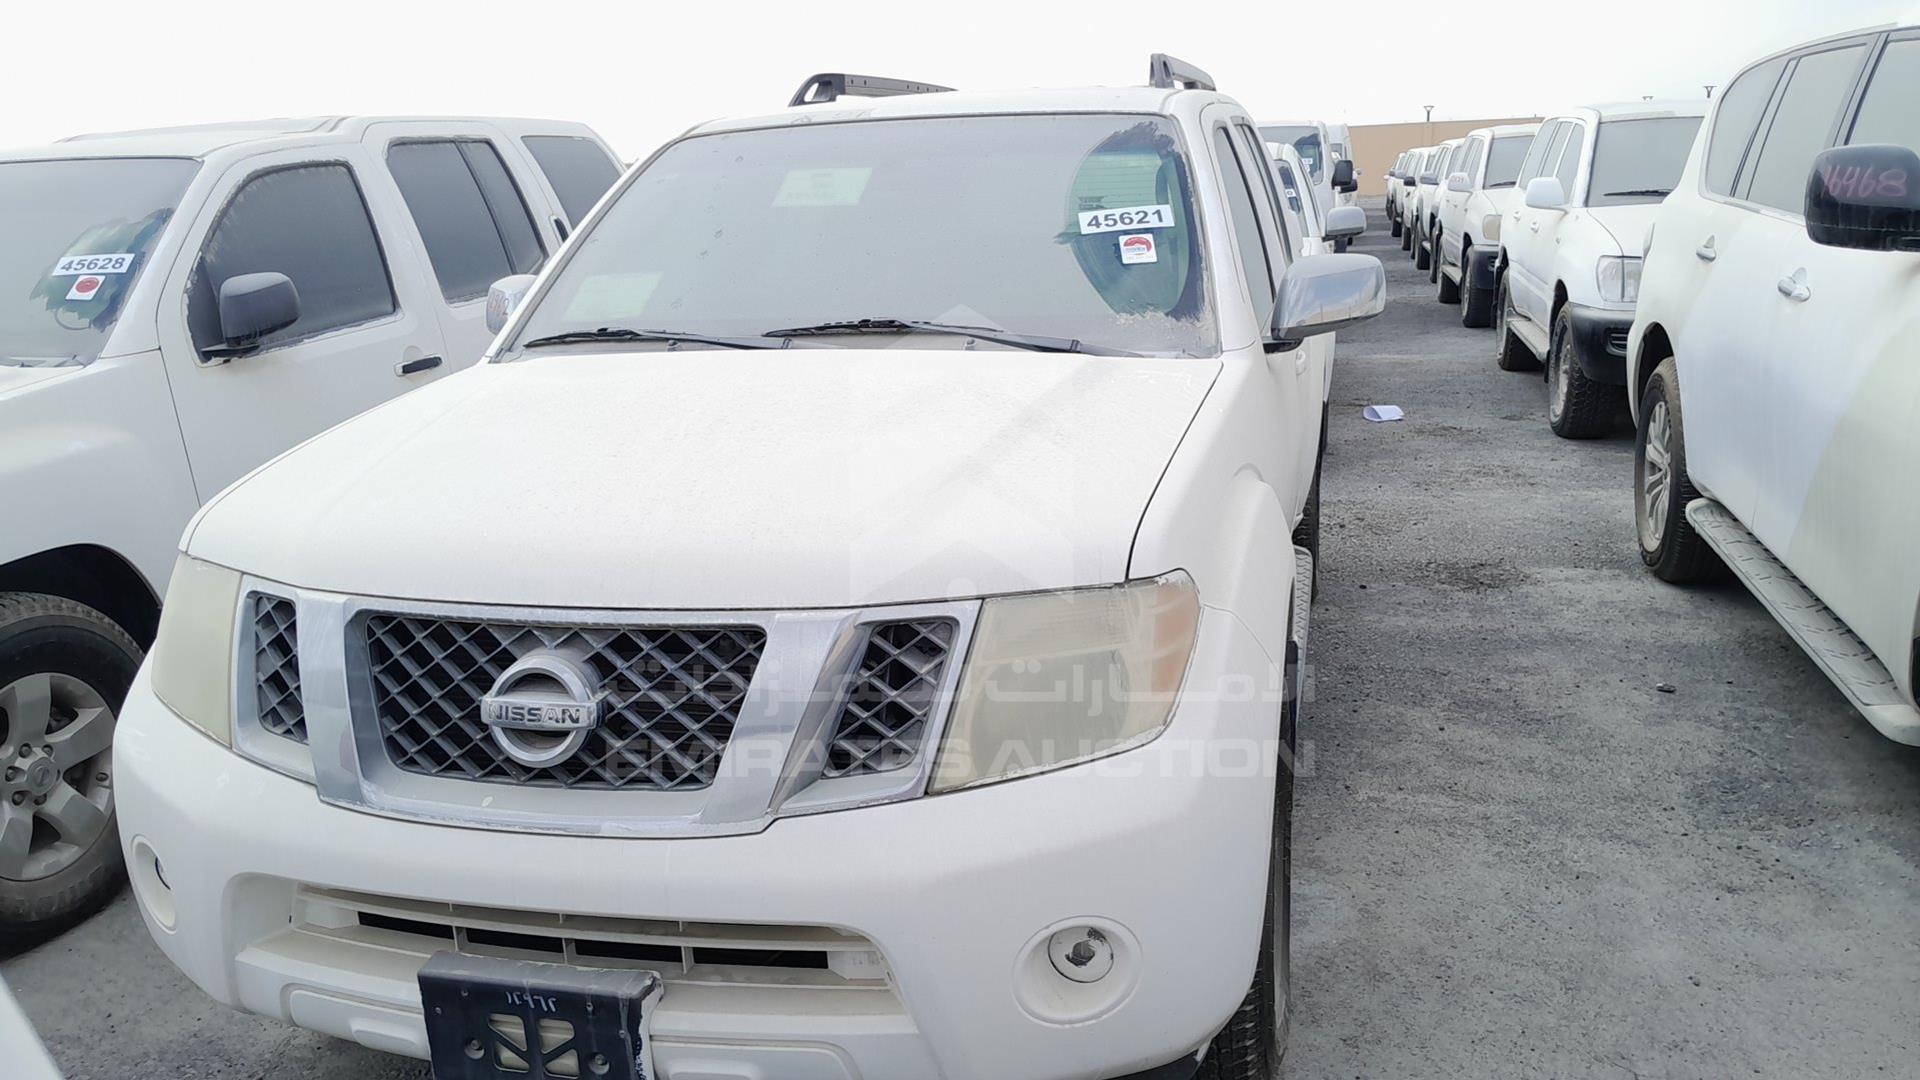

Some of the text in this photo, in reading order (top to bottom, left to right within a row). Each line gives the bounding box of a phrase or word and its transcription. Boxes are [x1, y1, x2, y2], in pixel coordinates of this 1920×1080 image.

[1087, 209, 1163, 228] 45621
[60, 257, 126, 272] 45628
[488, 703, 580, 724] NISSAN
